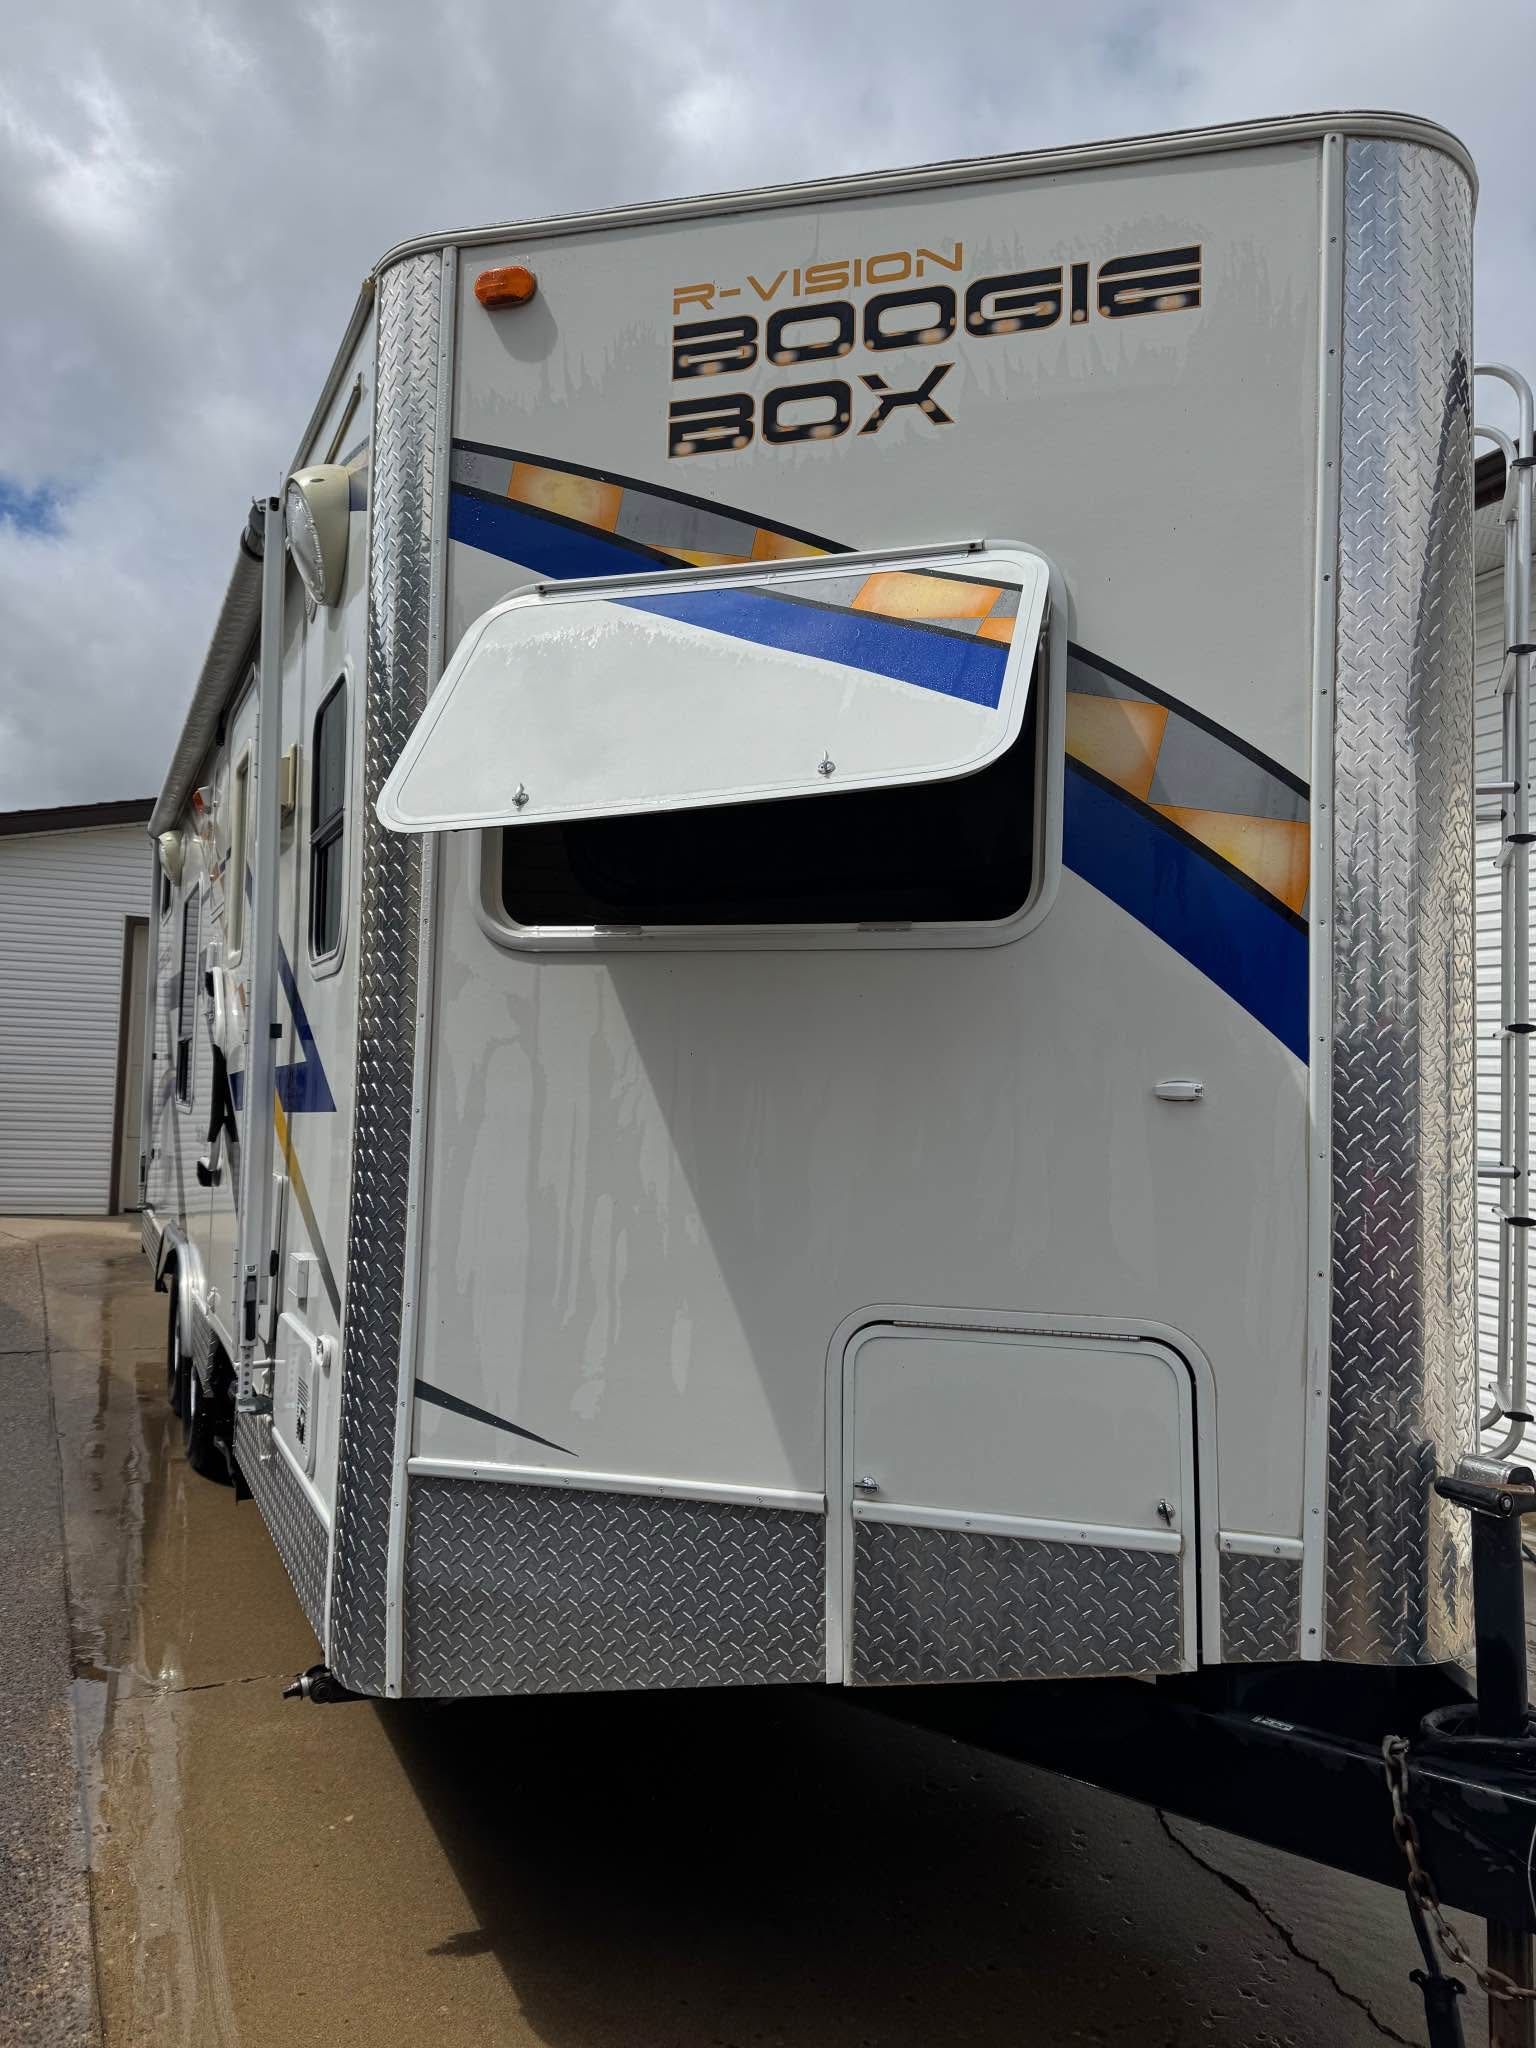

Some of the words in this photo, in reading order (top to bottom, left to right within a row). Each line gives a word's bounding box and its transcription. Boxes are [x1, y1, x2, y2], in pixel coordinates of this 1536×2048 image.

[672, 242, 963, 315] R-VISION
[672, 244, 1202, 381] BOOGIE
[668, 362, 955, 459] BOX
